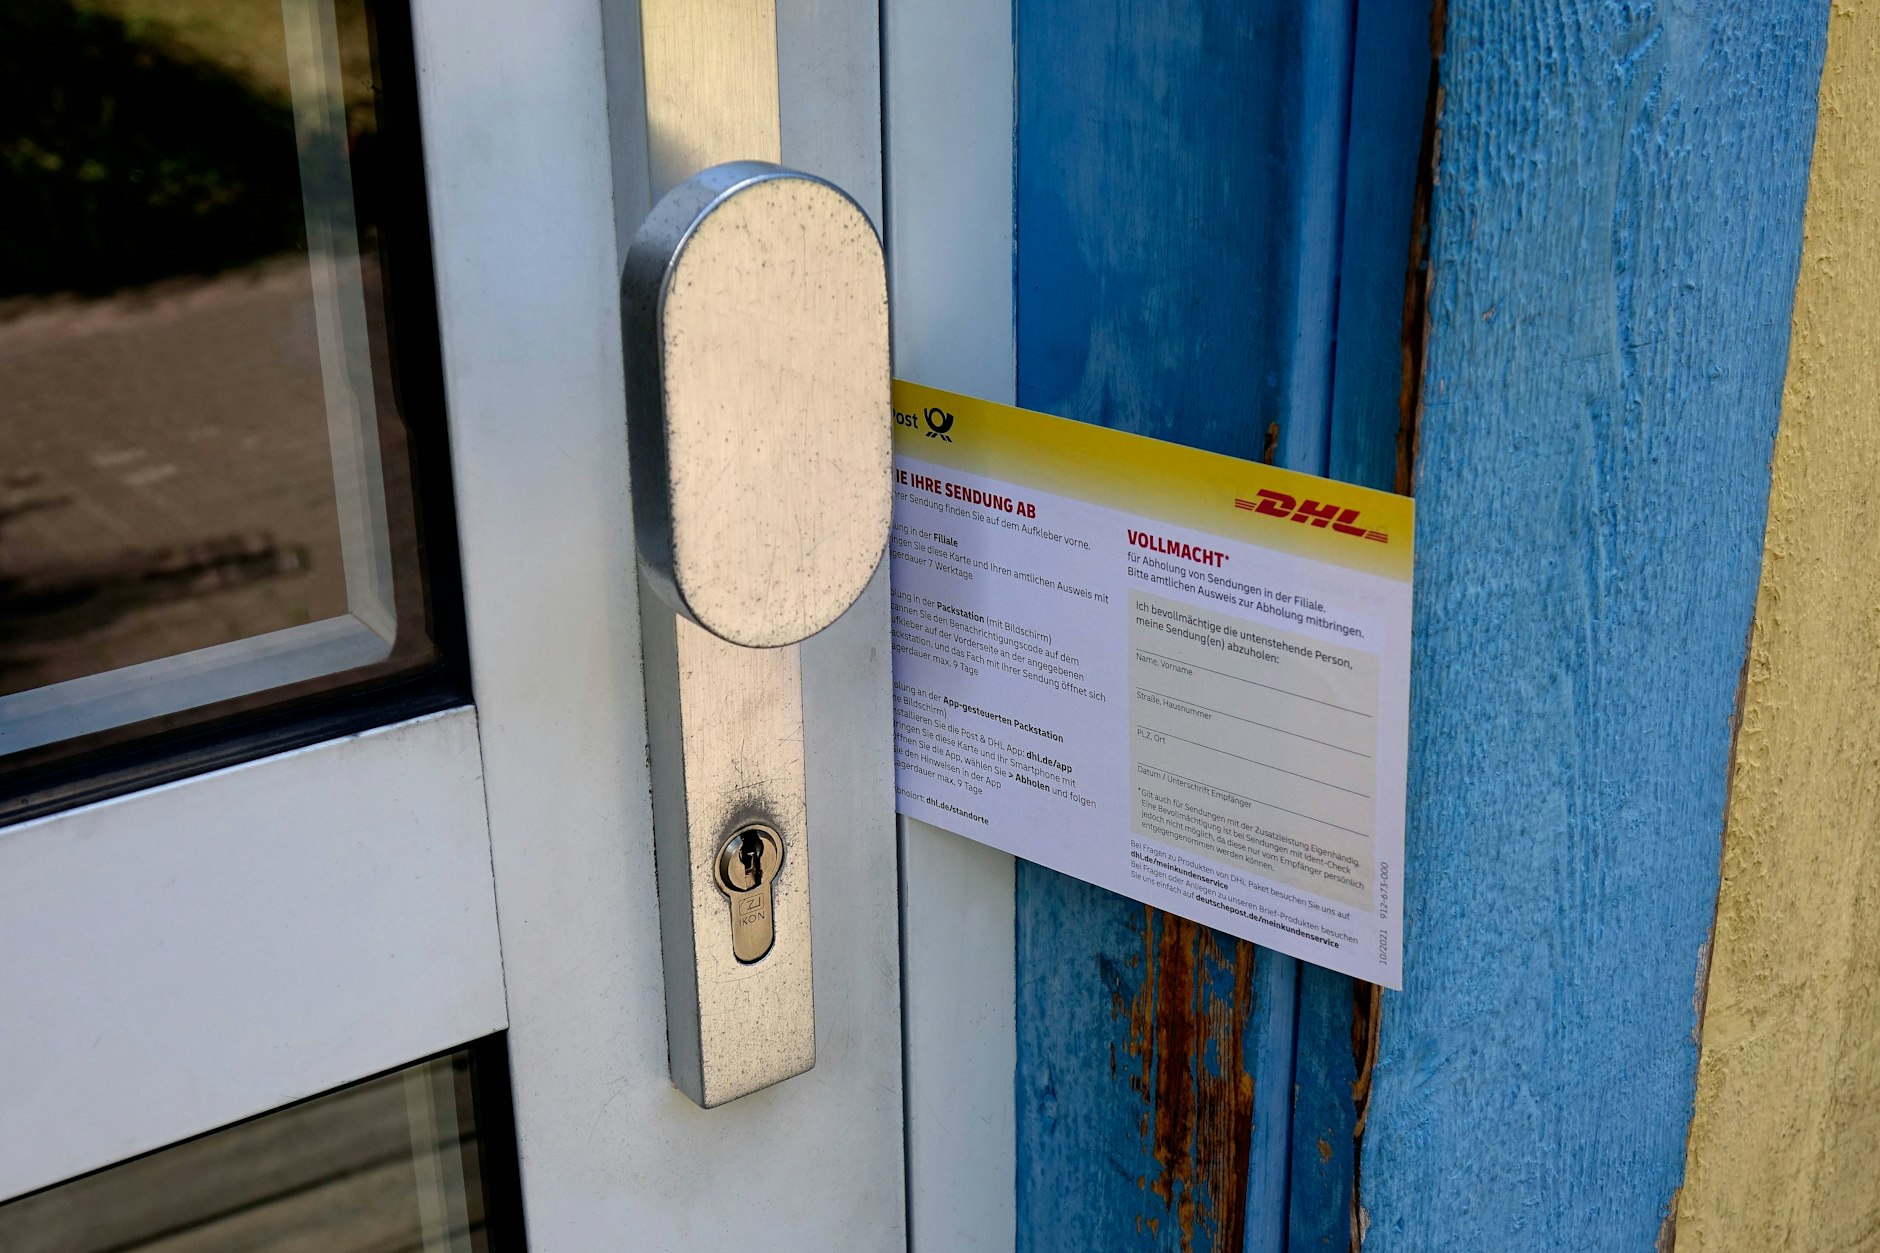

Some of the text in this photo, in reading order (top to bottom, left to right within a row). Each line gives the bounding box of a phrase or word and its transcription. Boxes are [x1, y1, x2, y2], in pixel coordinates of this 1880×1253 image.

[894, 468, 1035, 519] IE IHRE SENDUNG AB
[1255, 489, 1367, 537] DHL
[910, 494, 1090, 550] Sendung finden Sie auf dem Aufkleber vorne.
[910, 526, 917, 535] in
[919, 529, 932, 539] der
[933, 533, 958, 547] Filiale
[914, 541, 1108, 604] Sie diese Karte und Ihren amtlichen Ausweis mit
[928, 559, 973, 580] 7 Werktage
[1127, 551, 1326, 612] für Abholung von Sendungen in der Filiale.
[913, 594, 1051, 645] in der Packstation (mit Bildschirm)
[1128, 566, 1364, 638] Bitte amtlichen Ausweis zur Abholung mitbringen.
[892, 640, 978, 676] agerdauer max. 9 Tage
[920, 610, 1079, 666] Sie den Benachrichtigungscode auf dem
[925, 626, 1084, 681] auf der Vorderseite an der angegebenen
[1136, 600, 1352, 670] Ich bevollmächtige die untenstehende Person,
[1136, 617, 1279, 664] meine Sendung(en) abzuholen:
[892, 627, 1105, 702] ackstation, und das Fach mit Ihrer Sendung öffnet sich
[1136, 652, 1192, 676] Name, Vorname
[918, 689, 927, 697] an
[928, 692, 941, 702] der
[943, 696, 1012, 726] App-gesteuerten
[1014, 719, 1063, 743] Packstation
[1136, 691, 1212, 720] Straße, Hausnummer
[1137, 728, 1165, 744] PLZ, Ort
[937, 774, 955, 785] max.
[957, 779, 962, 787] 9
[964, 781, 982, 795] Tage
[1138, 765, 1251, 808] Datum Unterschrift Empfänger
[1130, 850, 1228, 890] dhl.de/meinkundenservice
[739, 911, 765, 927] IKON
[1379, 861, 1389, 965] 10/2021 912-673-000
